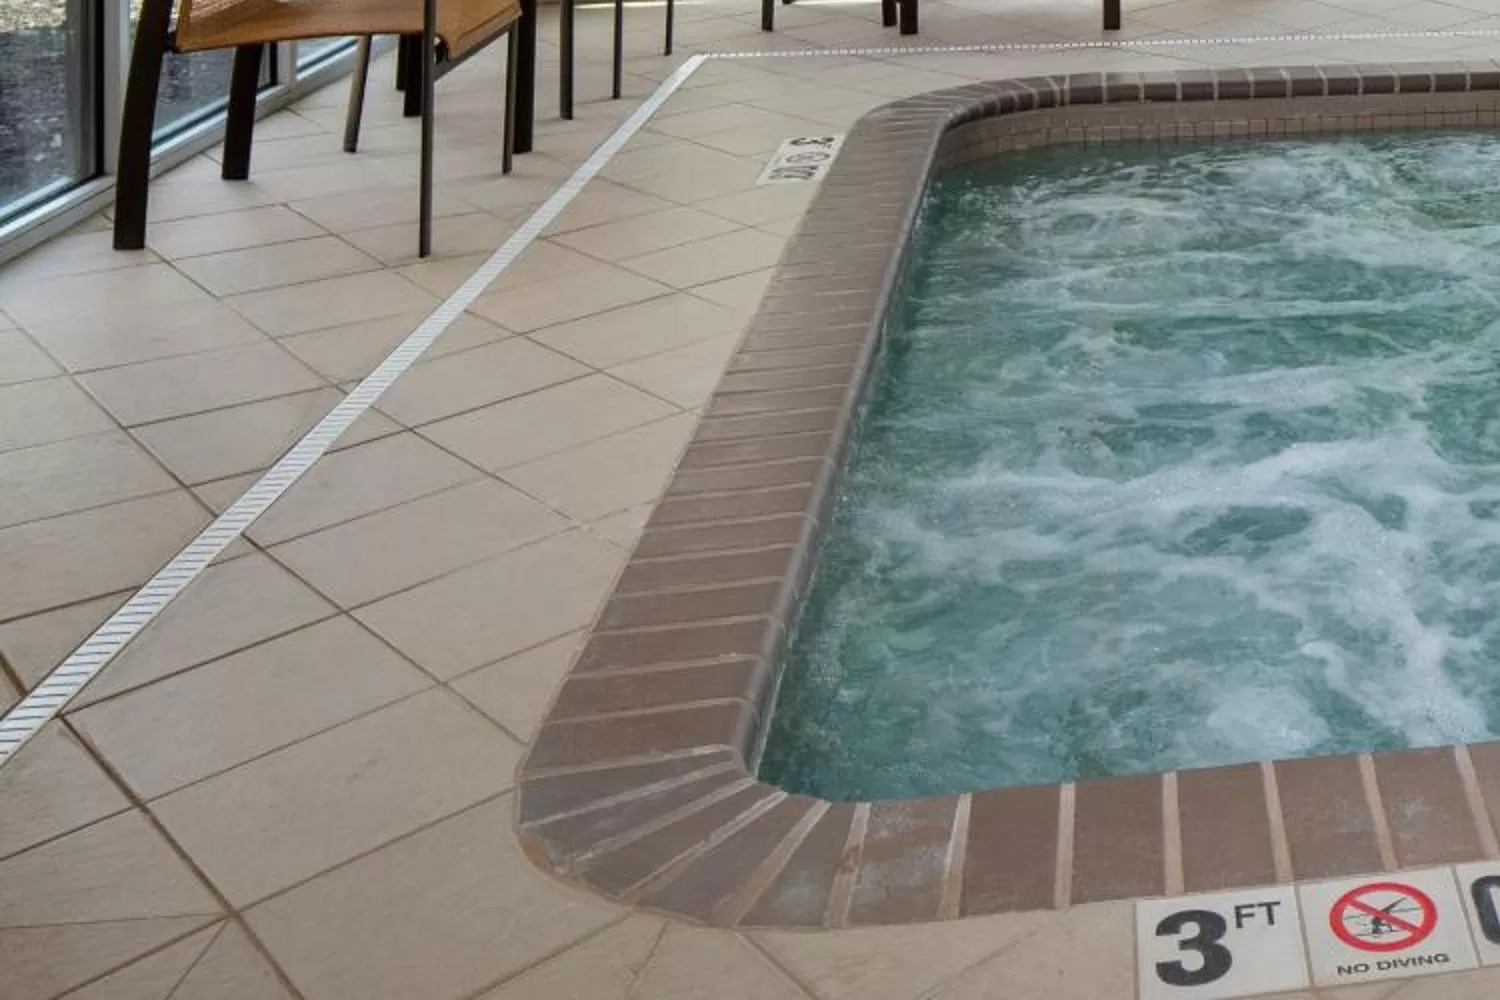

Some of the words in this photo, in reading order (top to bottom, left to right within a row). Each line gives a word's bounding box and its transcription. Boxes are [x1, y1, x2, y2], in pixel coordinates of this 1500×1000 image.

[1155, 909, 1233, 987] 3
[1235, 901, 1281, 929] FT
[1337, 962, 1370, 976] NO
[1376, 952, 1451, 973] DIVING
